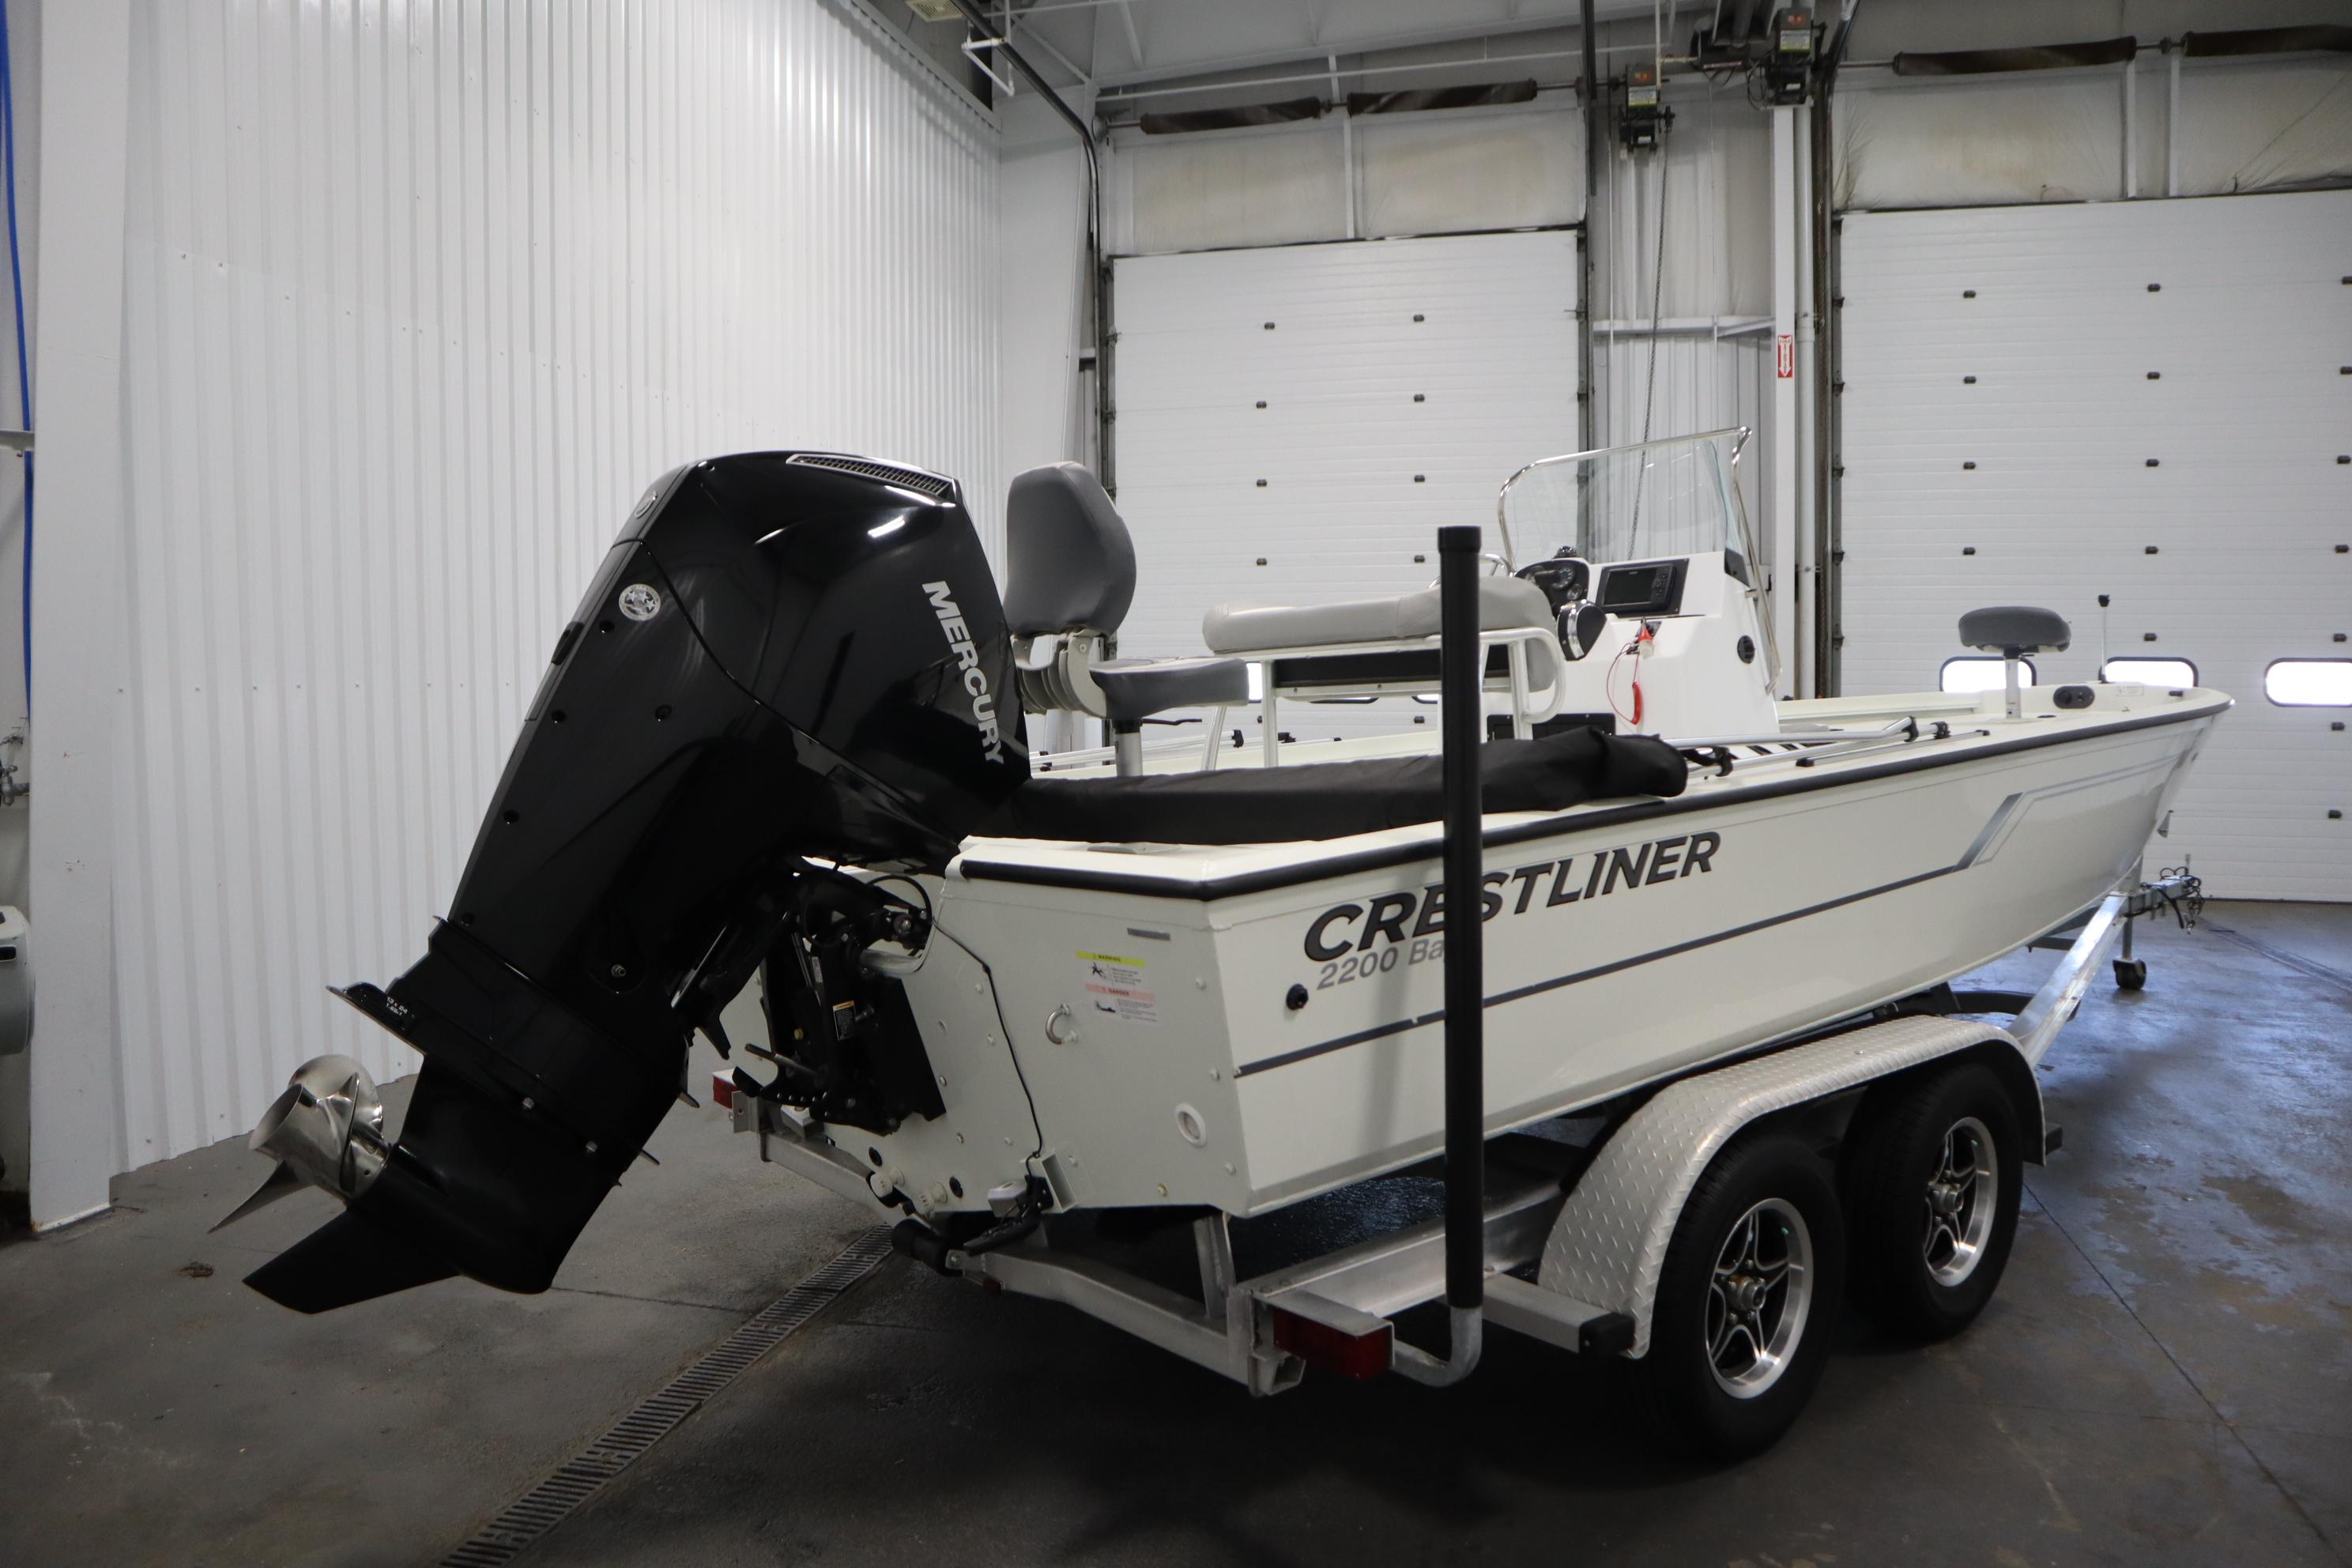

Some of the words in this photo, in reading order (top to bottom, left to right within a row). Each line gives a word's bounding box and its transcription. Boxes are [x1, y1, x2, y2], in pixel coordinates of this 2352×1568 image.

[922, 581, 1004, 764] MERCURY
[1304, 831, 1721, 962] CRESTLINER
[1316, 947, 1399, 989] 2200
[1408, 938, 1445, 966] Ba
